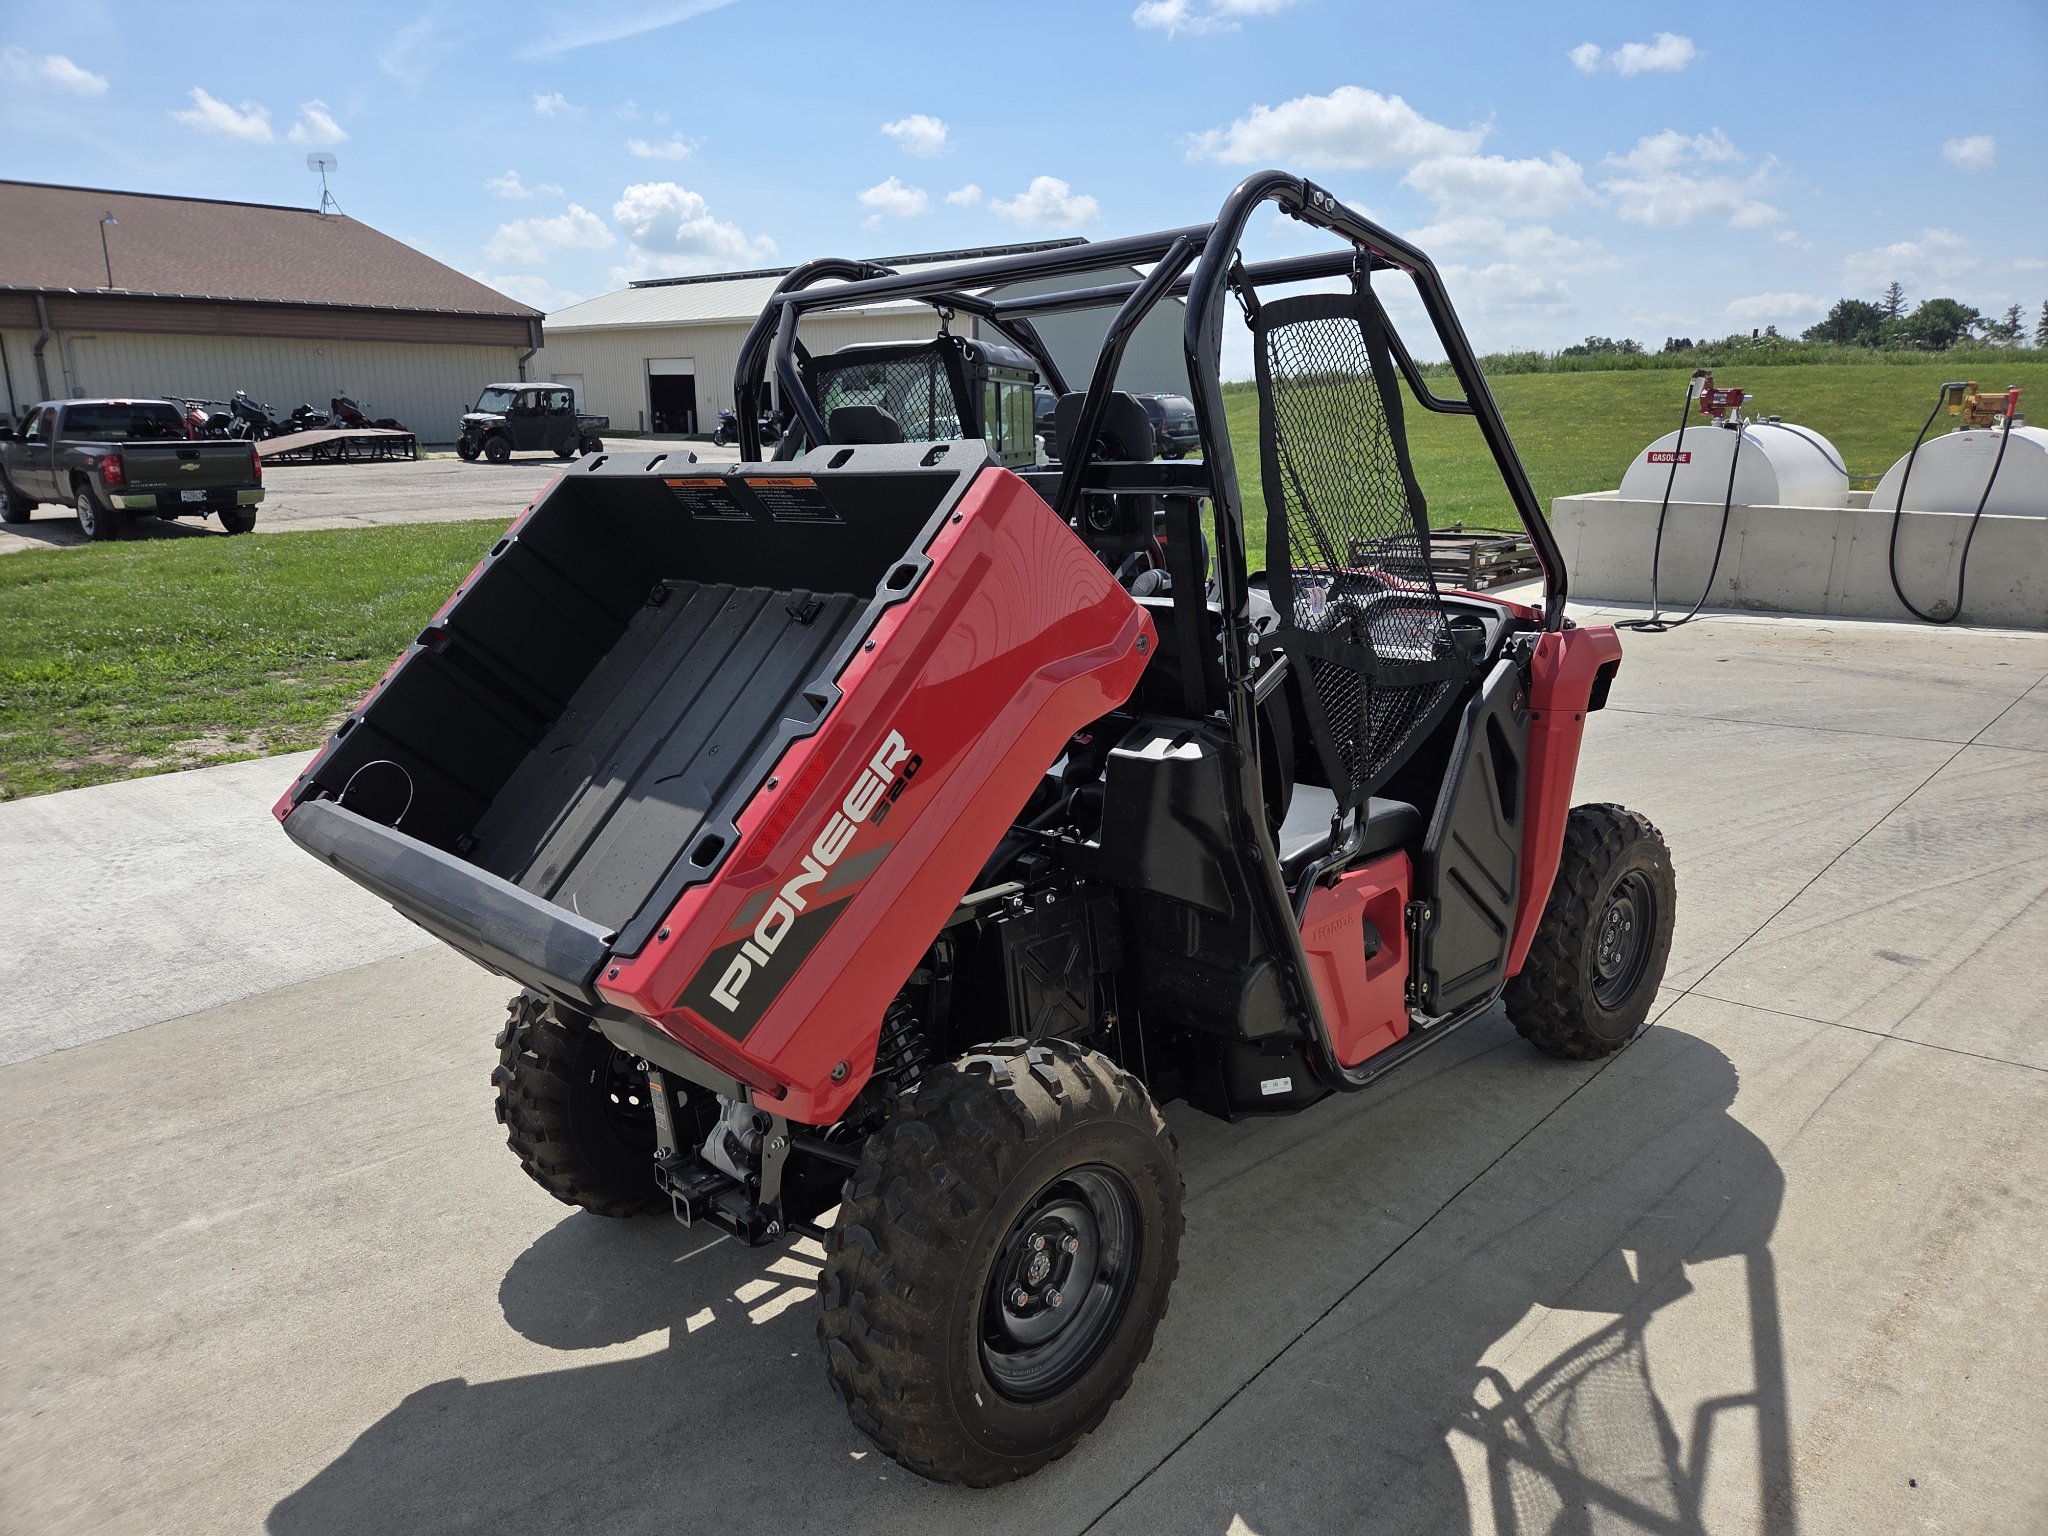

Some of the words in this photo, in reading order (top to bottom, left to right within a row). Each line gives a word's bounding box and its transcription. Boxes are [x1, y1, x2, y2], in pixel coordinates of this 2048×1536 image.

[870, 753, 924, 828] 520
[710, 728, 912, 1013] PIONEER
[1313, 914, 1354, 942] HONDA
